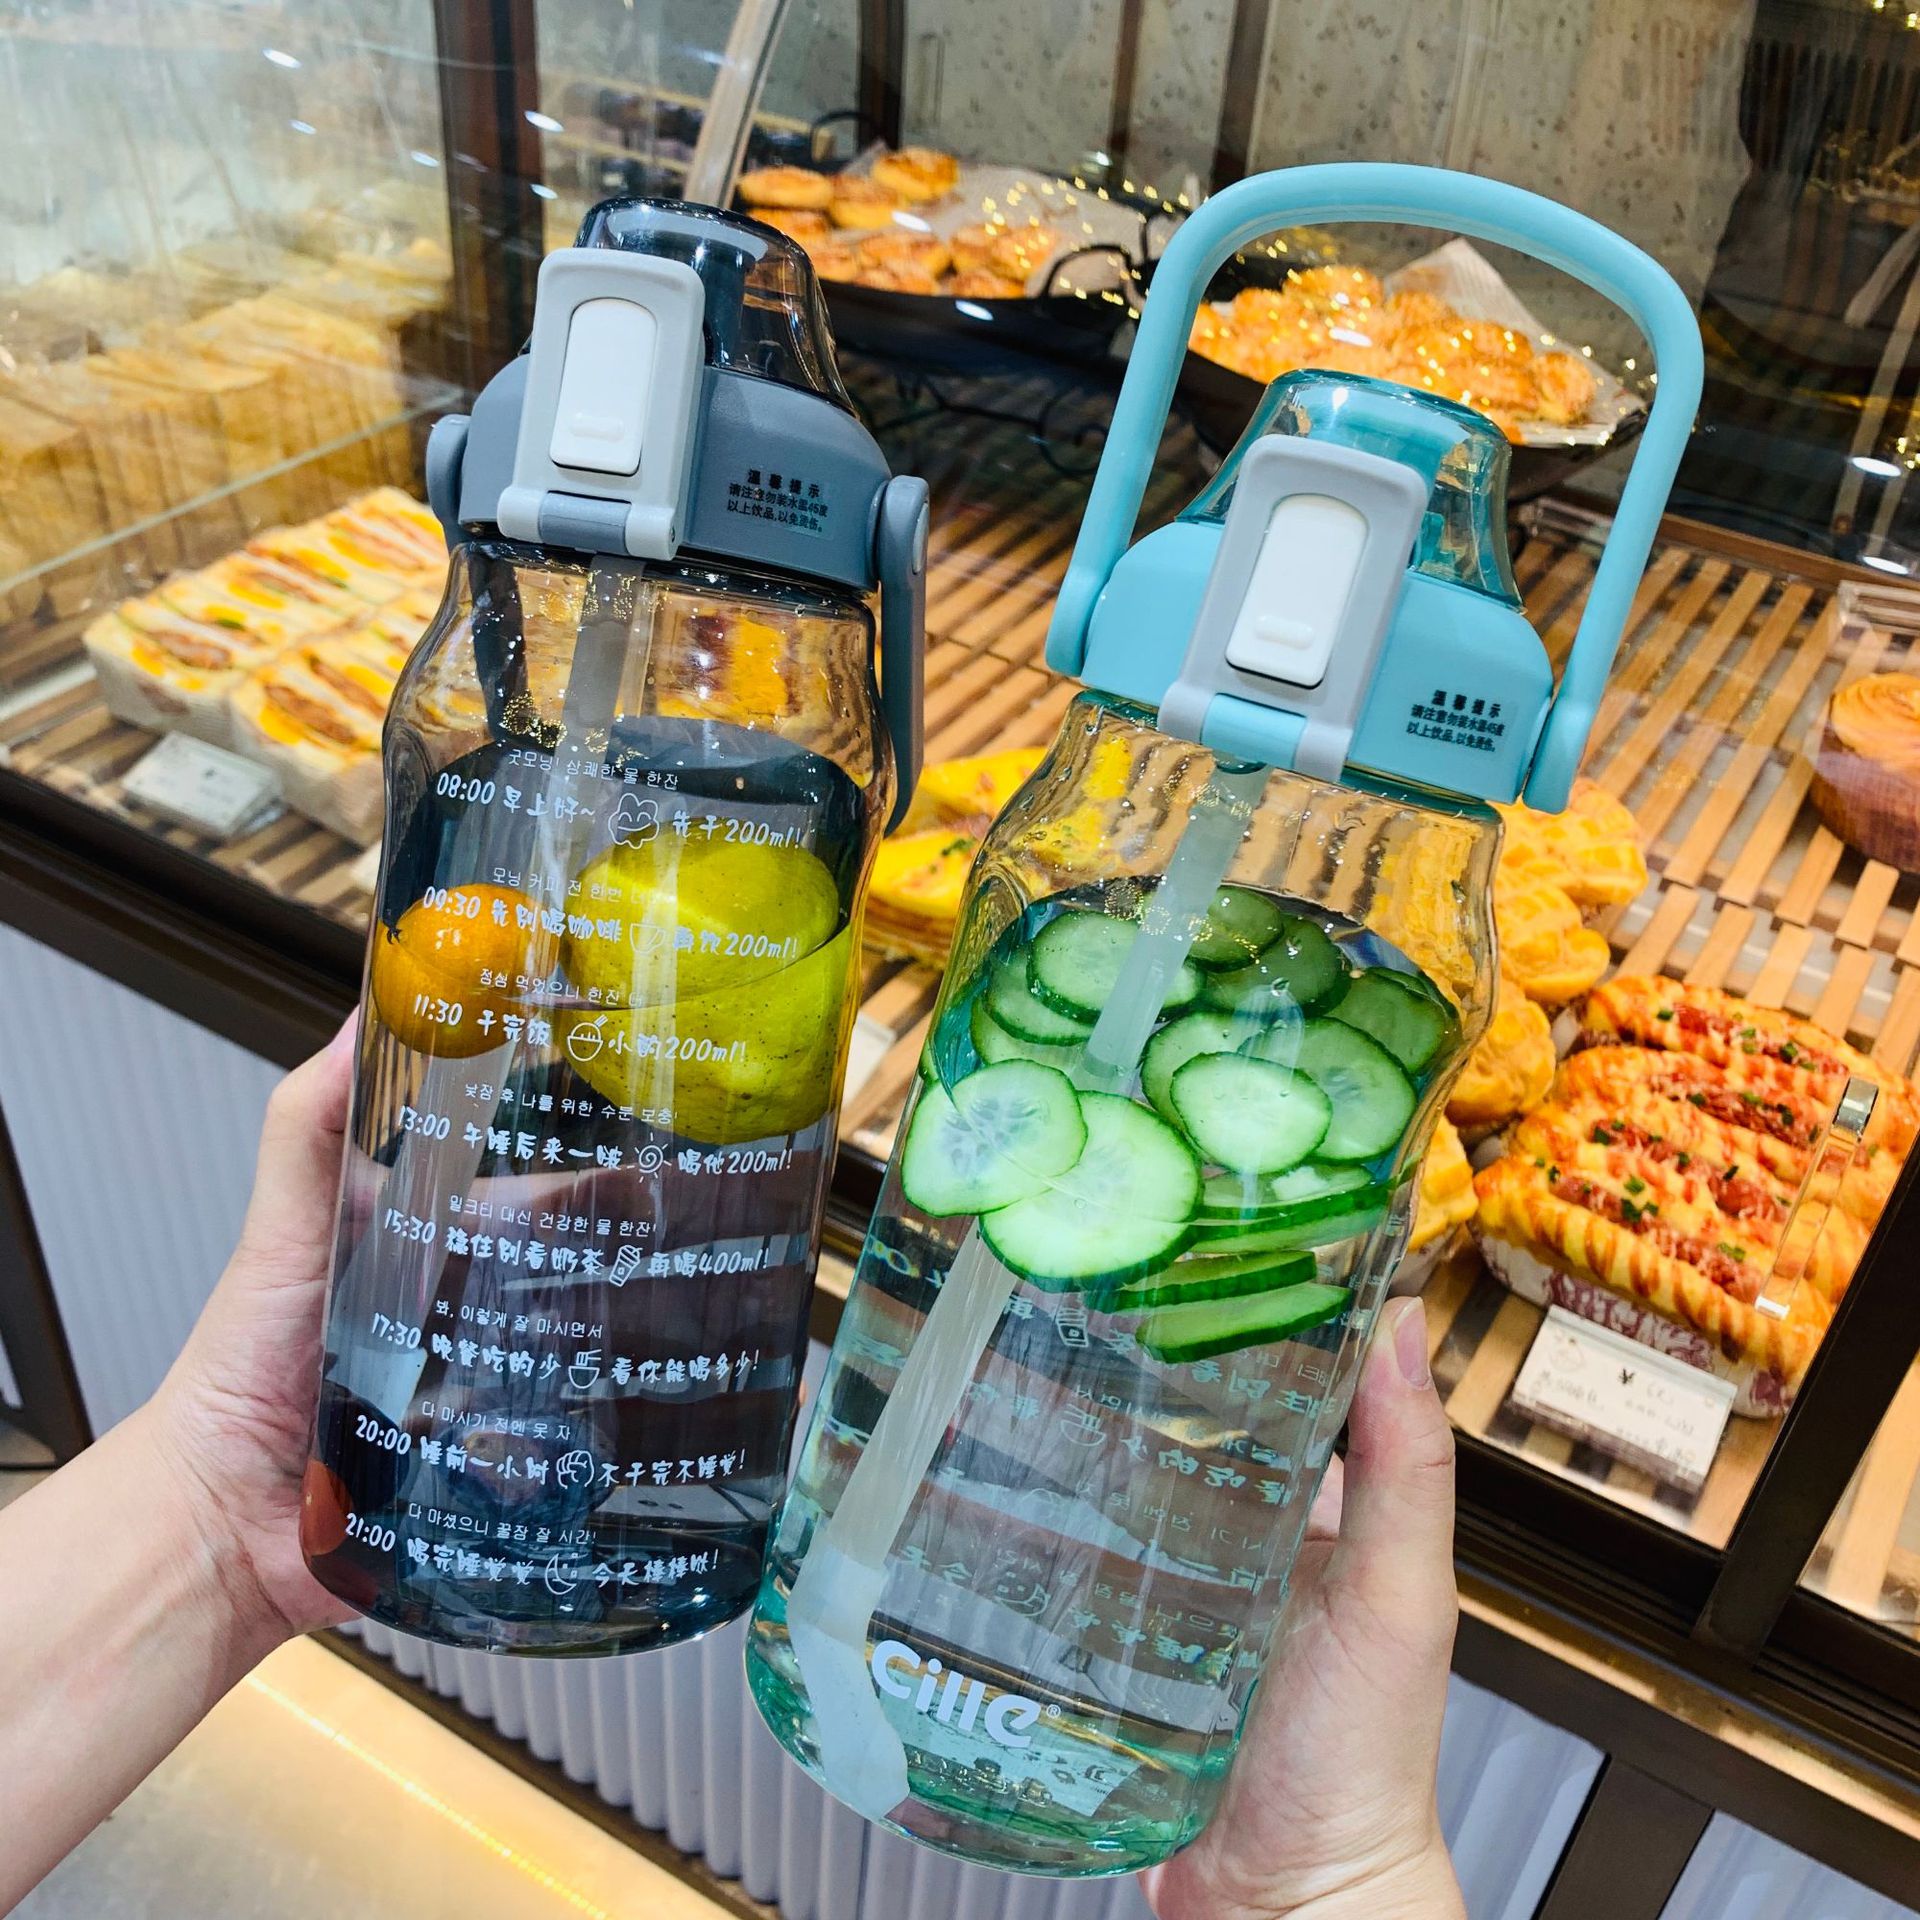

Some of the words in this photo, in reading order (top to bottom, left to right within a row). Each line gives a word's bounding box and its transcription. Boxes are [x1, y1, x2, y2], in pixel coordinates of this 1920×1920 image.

[436, 772, 496, 804] 08:00
[567, 760, 616, 781] 상쾌한
[647, 770, 679, 790] 한잔
[493, 867, 521, 886] 모닝
[568, 880, 582, 896] 전
[423, 886, 481, 919] 09:30
[516, 975, 579, 1000] 먹었으니
[588, 987, 620, 1005] 한잔
[414, 994, 462, 1026] 11:30
[477, 1009, 550, 1047] 干完饭
[500, 1088, 515, 1104] 후
[522, 1094, 553, 1112] 나를
[561, 1098, 594, 1117] 위한
[399, 1105, 450, 1141] 13:00
[384, 1208, 436, 1244] 15:30
[500, 1206, 531, 1226] 대신
[539, 1212, 589, 1233] 건강한
[461, 1305, 507, 1328] 이렇게
[514, 1315, 529, 1332] 잘
[536, 1318, 602, 1339] 마시면서
[371, 1312, 422, 1349] 17:30
[432, 1333, 561, 1380] 晚餐吃的少
[422, 1401, 435, 1418] 다
[441, 1406, 487, 1430] 마시기
[494, 1417, 526, 1437] 전엔
[556, 1425, 570, 1441] 자
[356, 1414, 412, 1455] 20:00
[420, 1436, 550, 1485] 睡前一小时
[345, 1512, 396, 1552] 21:00
[409, 1502, 422, 1520] 다
[536, 1528, 551, 1543] 잘
[558, 1529, 596, 1545] 시간!
